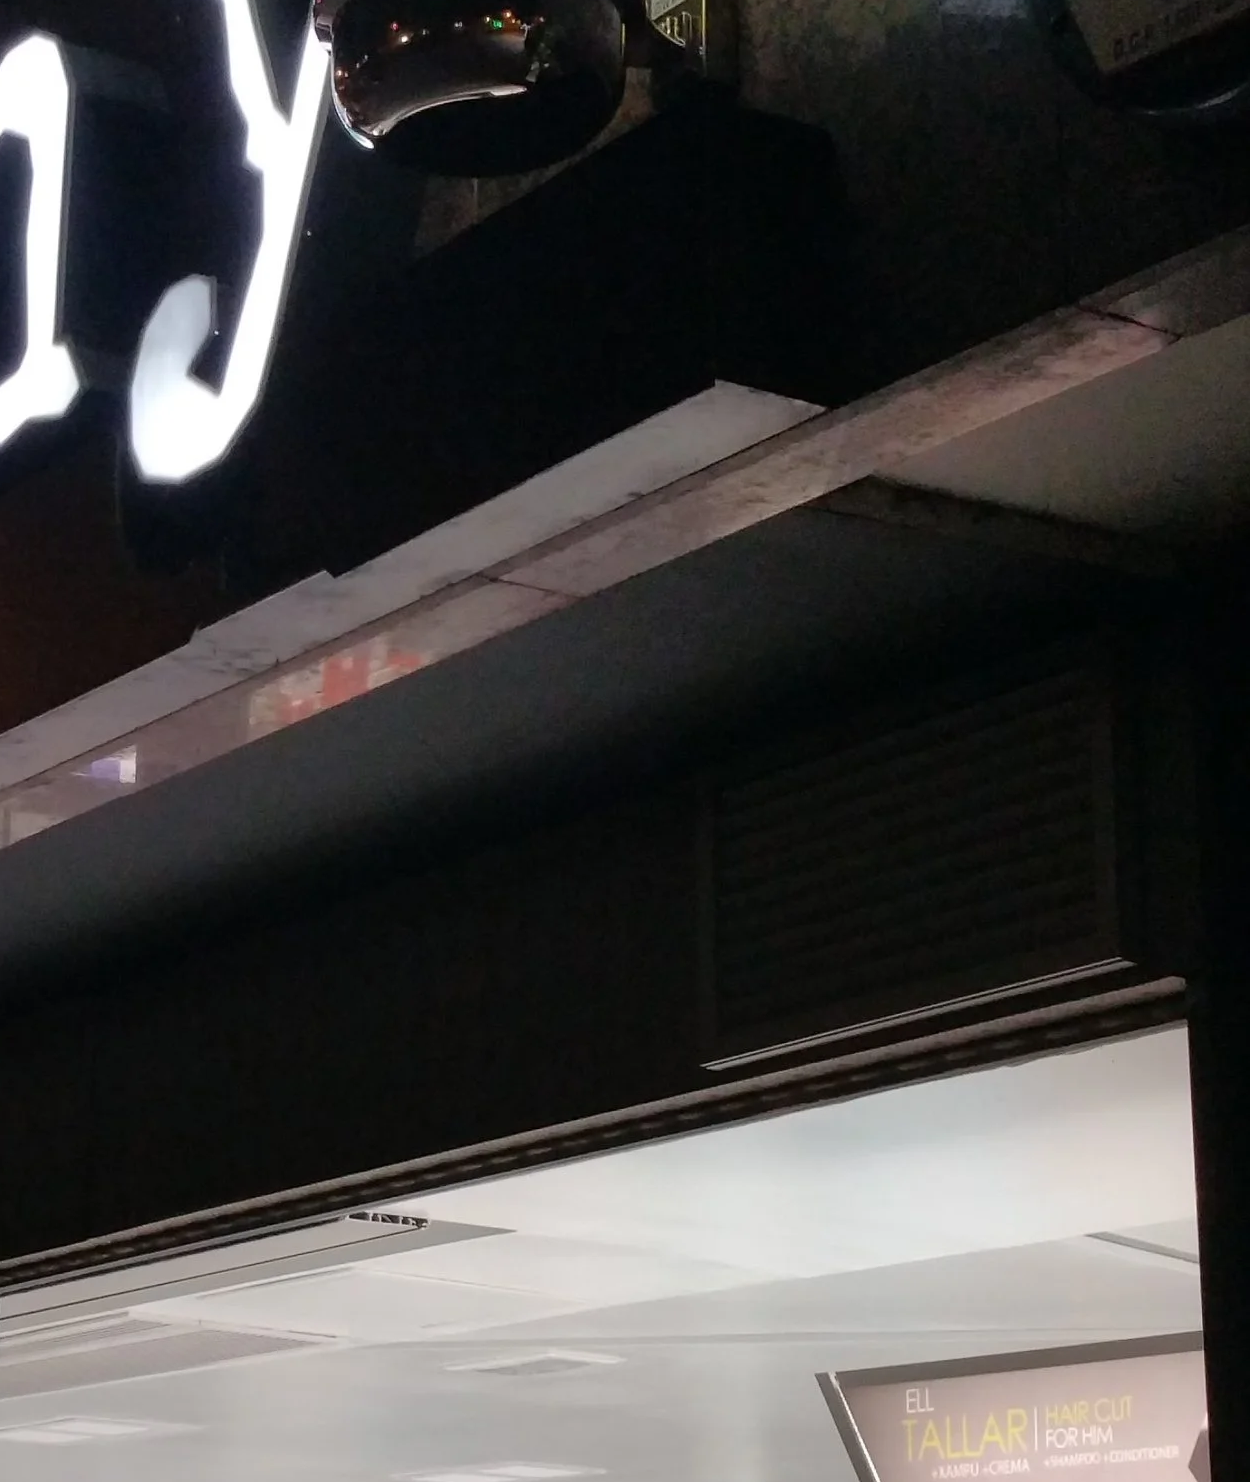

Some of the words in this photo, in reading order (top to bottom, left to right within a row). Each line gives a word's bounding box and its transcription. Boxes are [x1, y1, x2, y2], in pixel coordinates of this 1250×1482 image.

[906, 1388, 934, 1413] ELL
[1046, 1401, 1088, 1427] HAIR
[1095, 1395, 1133, 1423] CUT
[902, 1408, 1028, 1461] TALLAR
[1046, 1428, 1078, 1450] FOR
[1082, 1425, 1113, 1447] HIM
